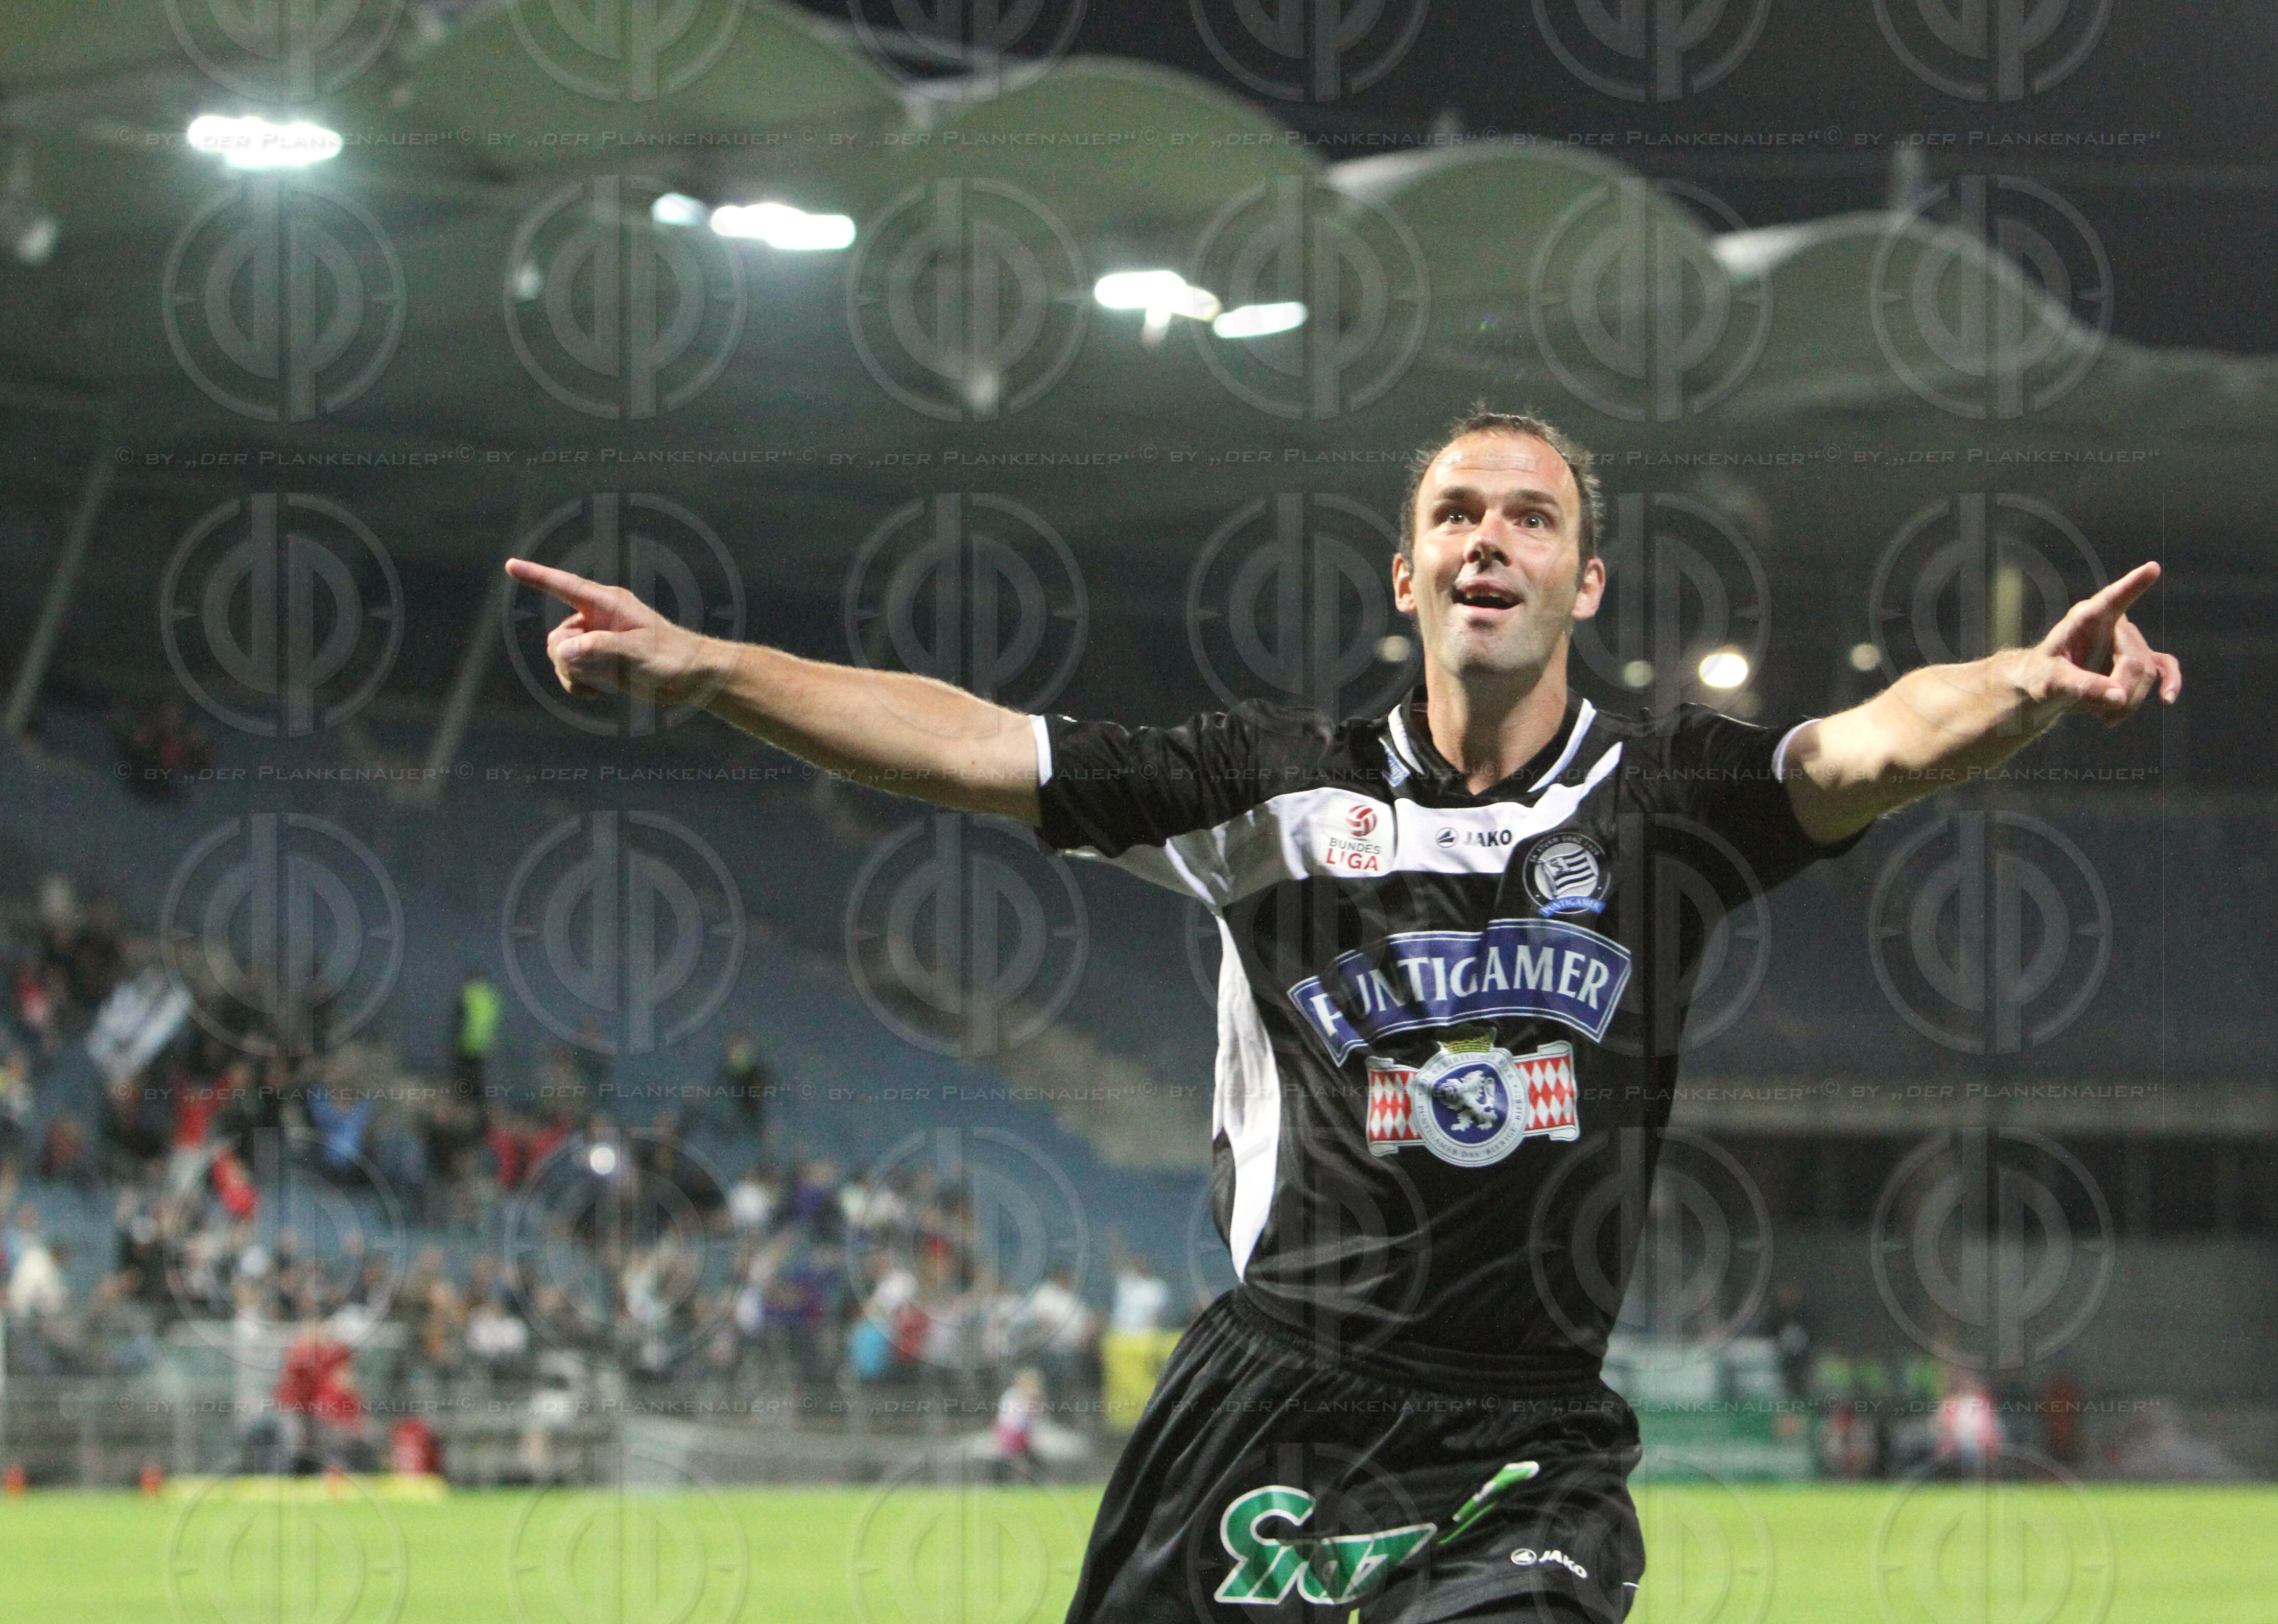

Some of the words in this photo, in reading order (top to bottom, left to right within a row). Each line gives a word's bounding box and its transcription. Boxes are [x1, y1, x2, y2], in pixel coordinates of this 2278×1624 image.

[1329, 838, 1381, 854] BUNDES
[1464, 829, 1512, 847] JAKO
[1326, 848, 1378, 871] LIGA
[1538, 1549, 1587, 1579] JAKO
